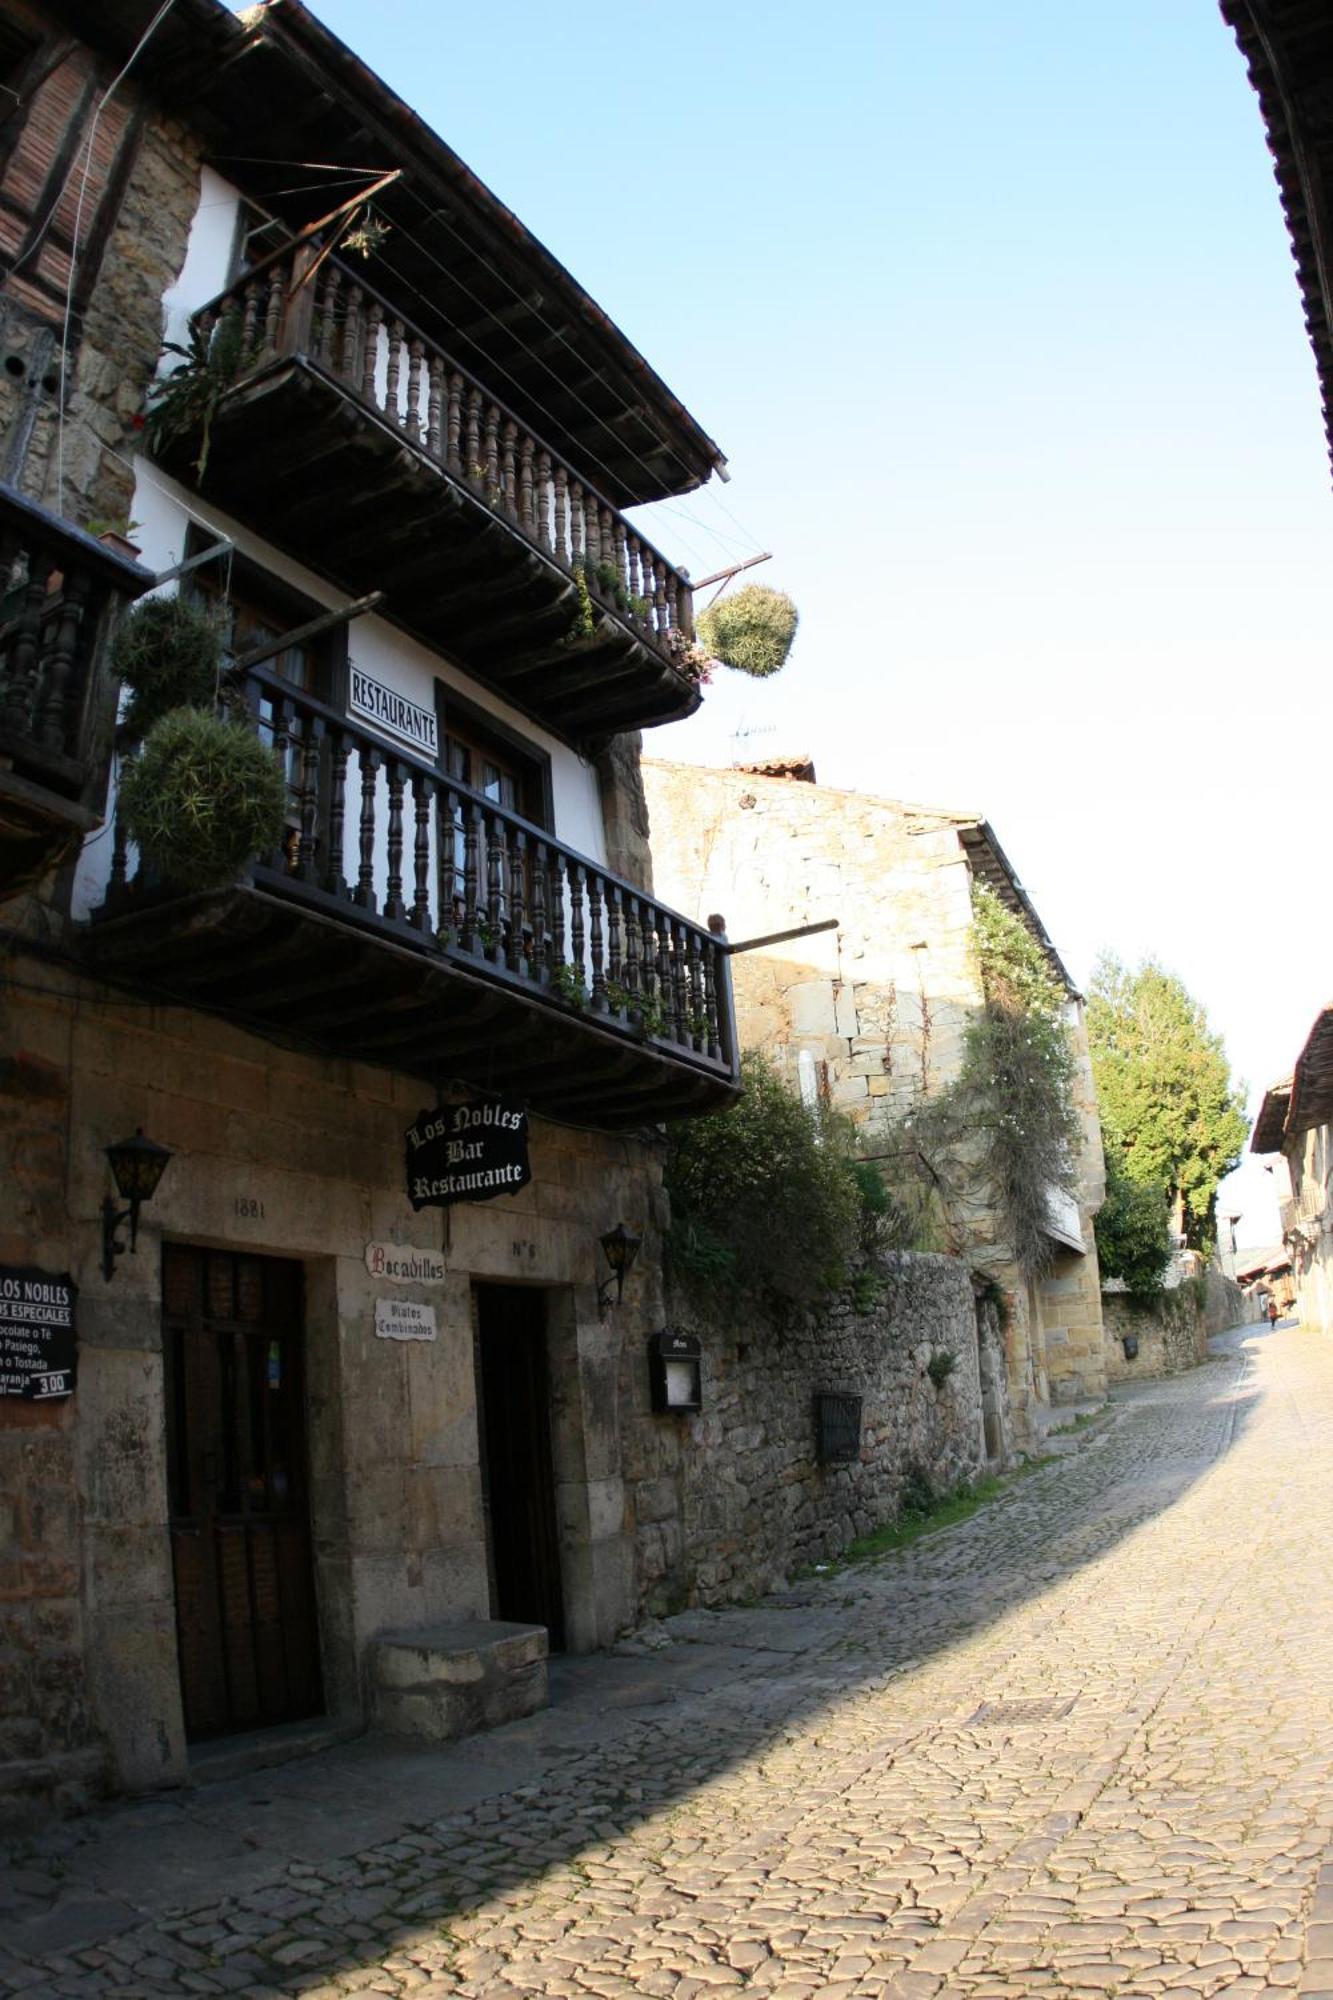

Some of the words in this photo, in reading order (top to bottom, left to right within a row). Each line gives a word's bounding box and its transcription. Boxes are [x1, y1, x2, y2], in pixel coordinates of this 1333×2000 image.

[353, 672, 436, 746] RESTAURANTE
[406, 1119, 446, 1149] Los
[450, 1104, 524, 1132] Nobles
[446, 1140, 484, 1167] Bar
[414, 1163, 522, 1198] Restaurante
[371, 1244, 444, 1280] Bocadillos
[25, 1282, 69, 1305] NOBLES
[12, 1305, 70, 1323] ESPECIALES
[32, 1329, 40, 1339] o
[5, 1357, 12, 1367] o
[14, 1356, 48, 1370] Tostada
